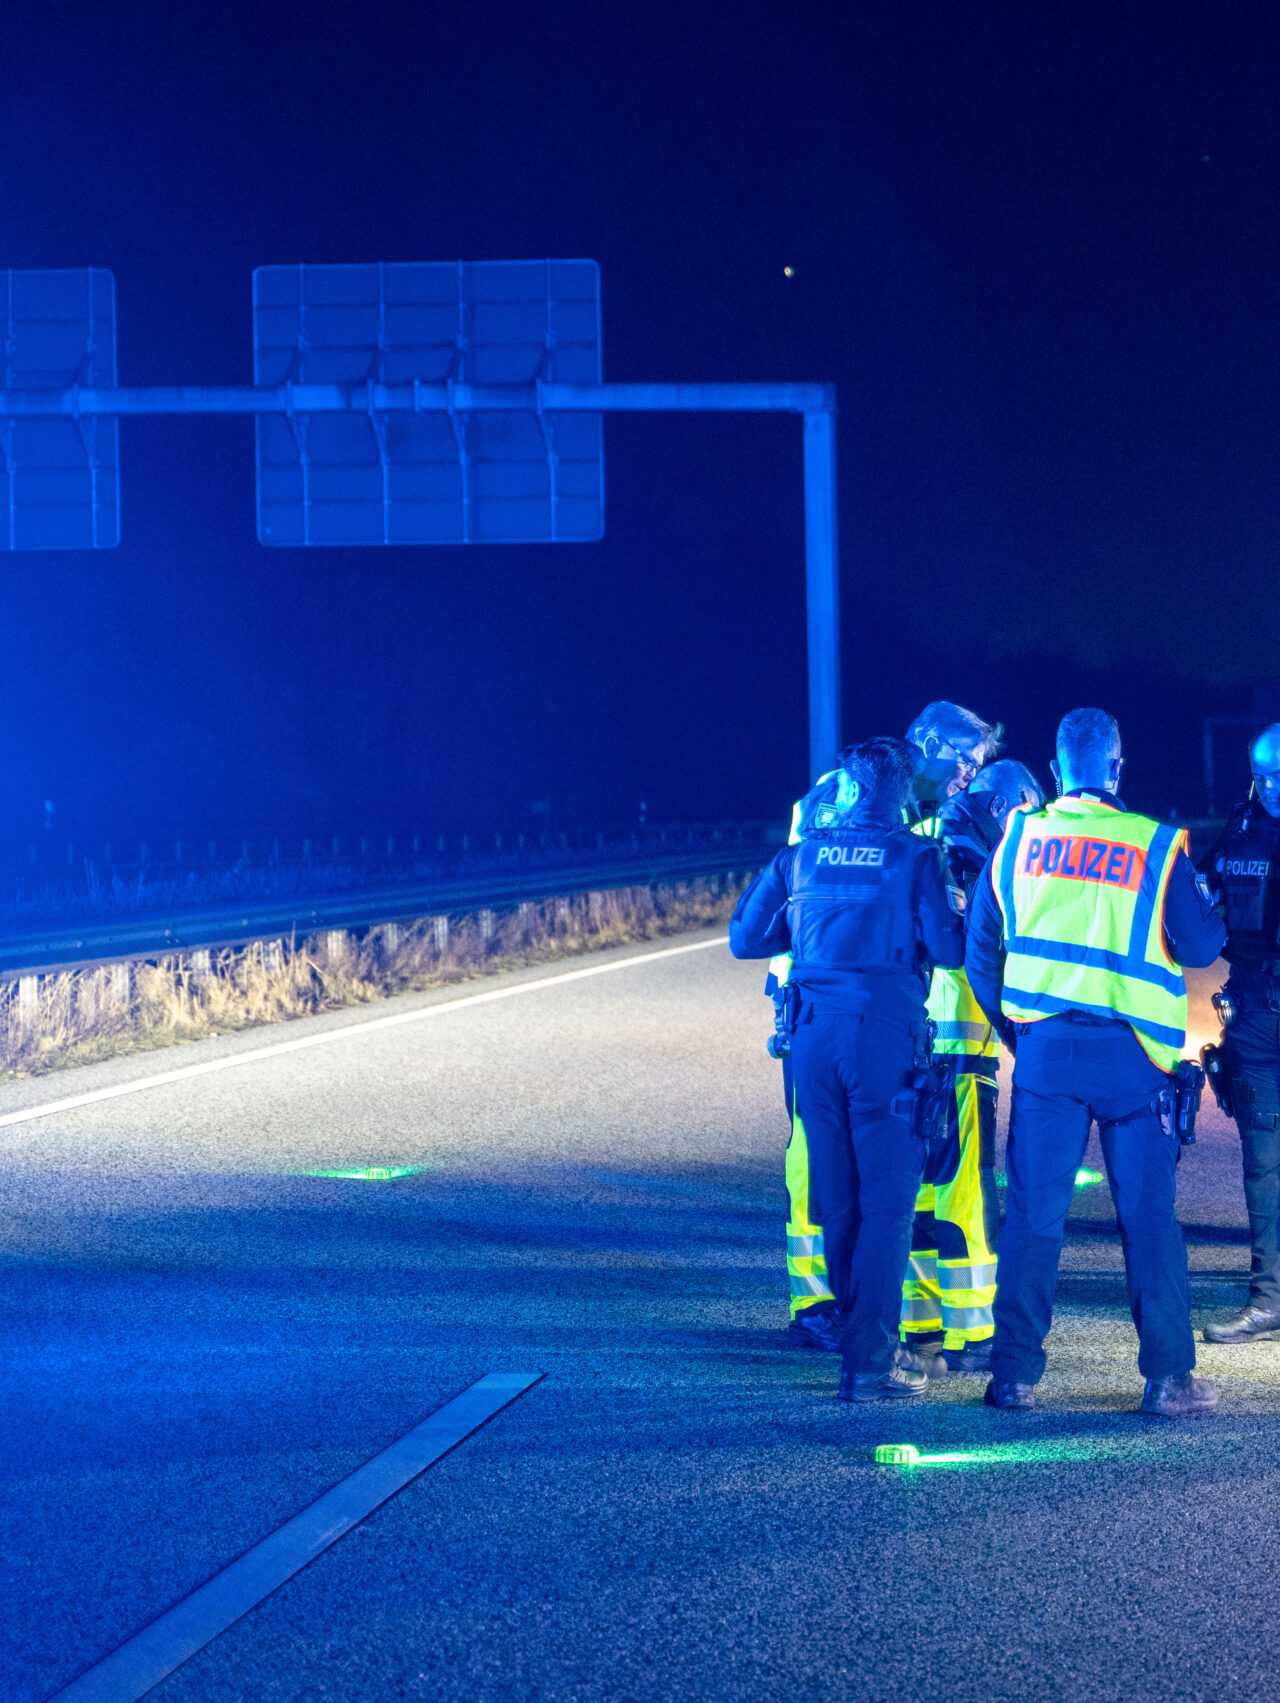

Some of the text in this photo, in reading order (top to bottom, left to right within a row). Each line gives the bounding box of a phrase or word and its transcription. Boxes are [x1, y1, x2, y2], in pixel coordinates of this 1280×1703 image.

[815, 845, 886, 867] POLIZEI
[1025, 837, 1136, 886] POLIZEI
[1226, 858, 1270, 876] POLIZEI
